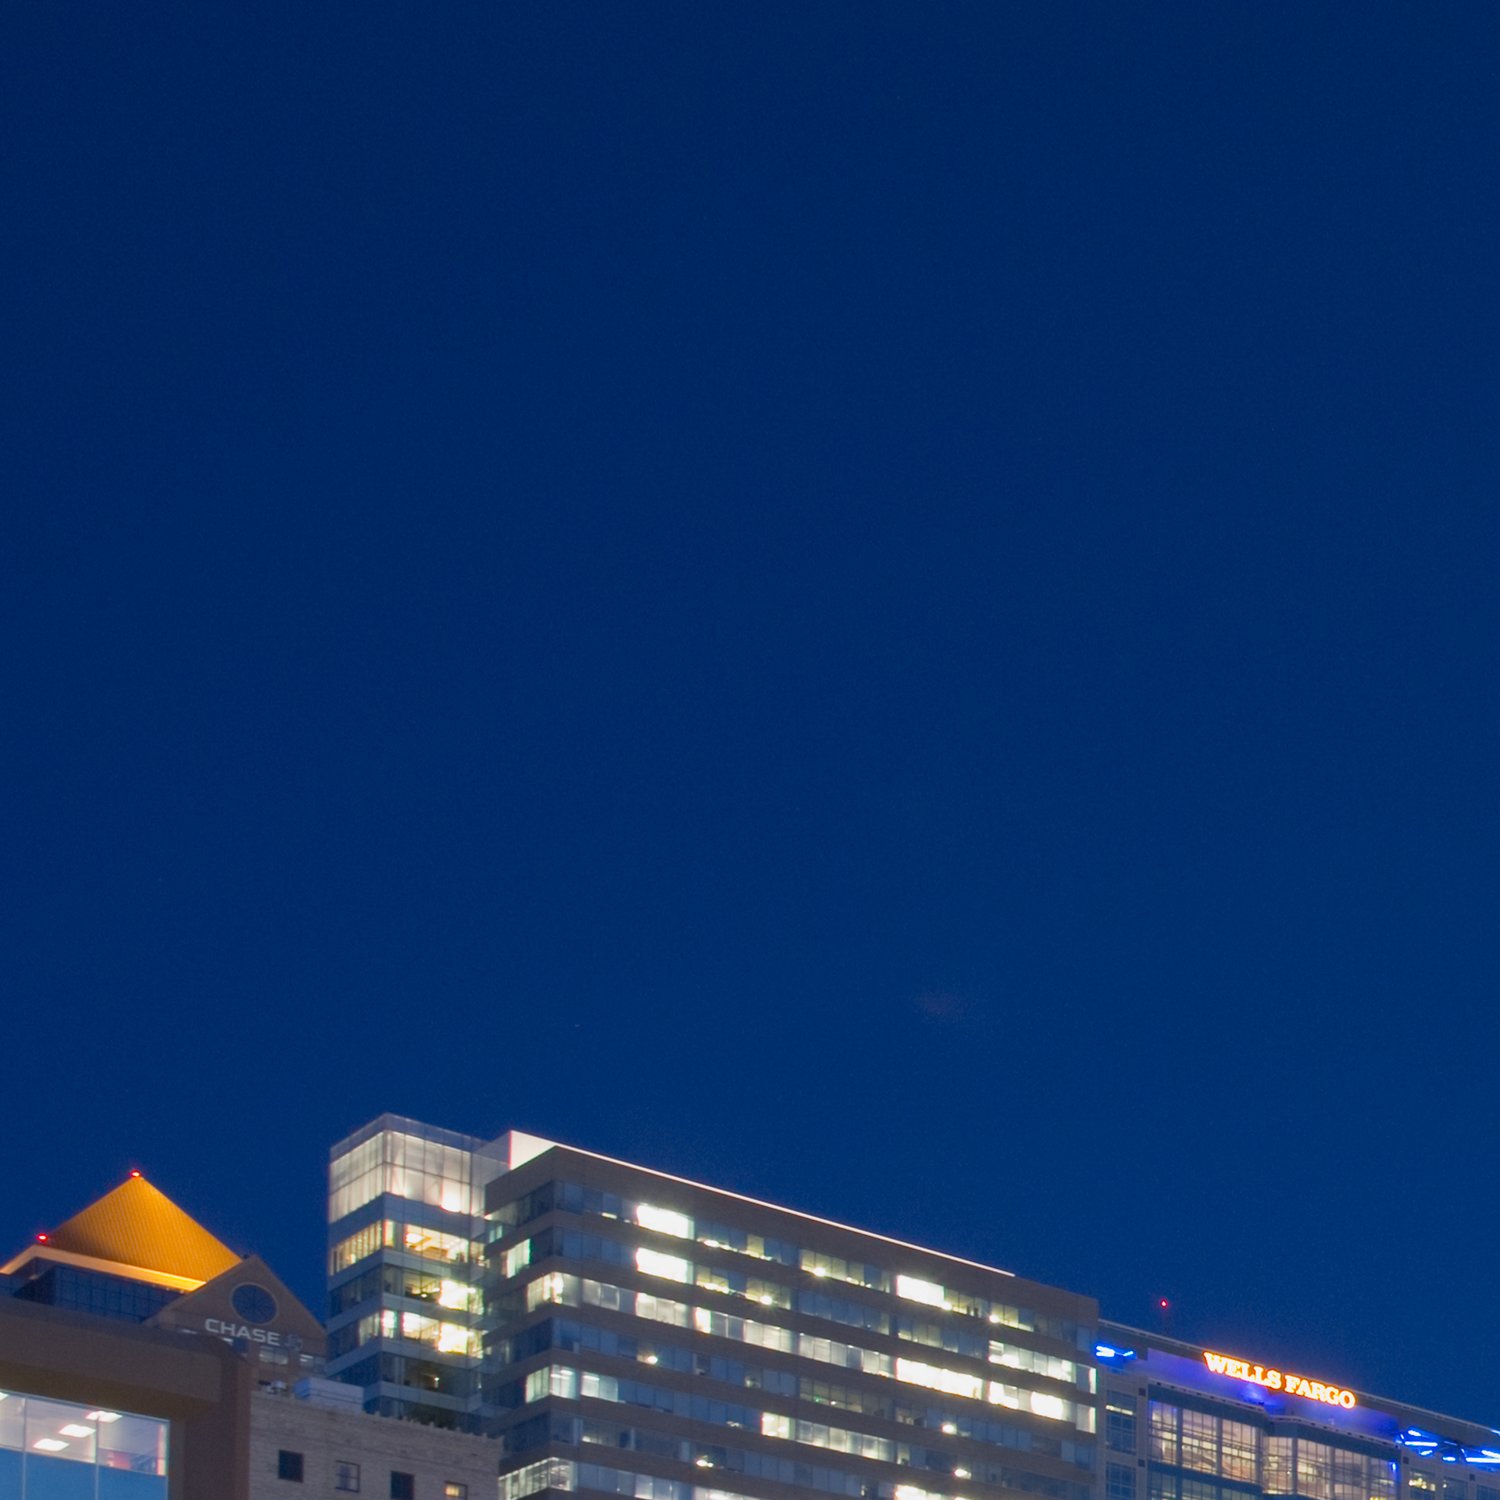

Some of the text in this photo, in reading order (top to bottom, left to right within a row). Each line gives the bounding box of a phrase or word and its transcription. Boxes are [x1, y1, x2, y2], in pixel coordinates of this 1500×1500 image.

[205, 1318, 281, 1346] CHASE
[1203, 1351, 1356, 1409] WELLS FARGO
